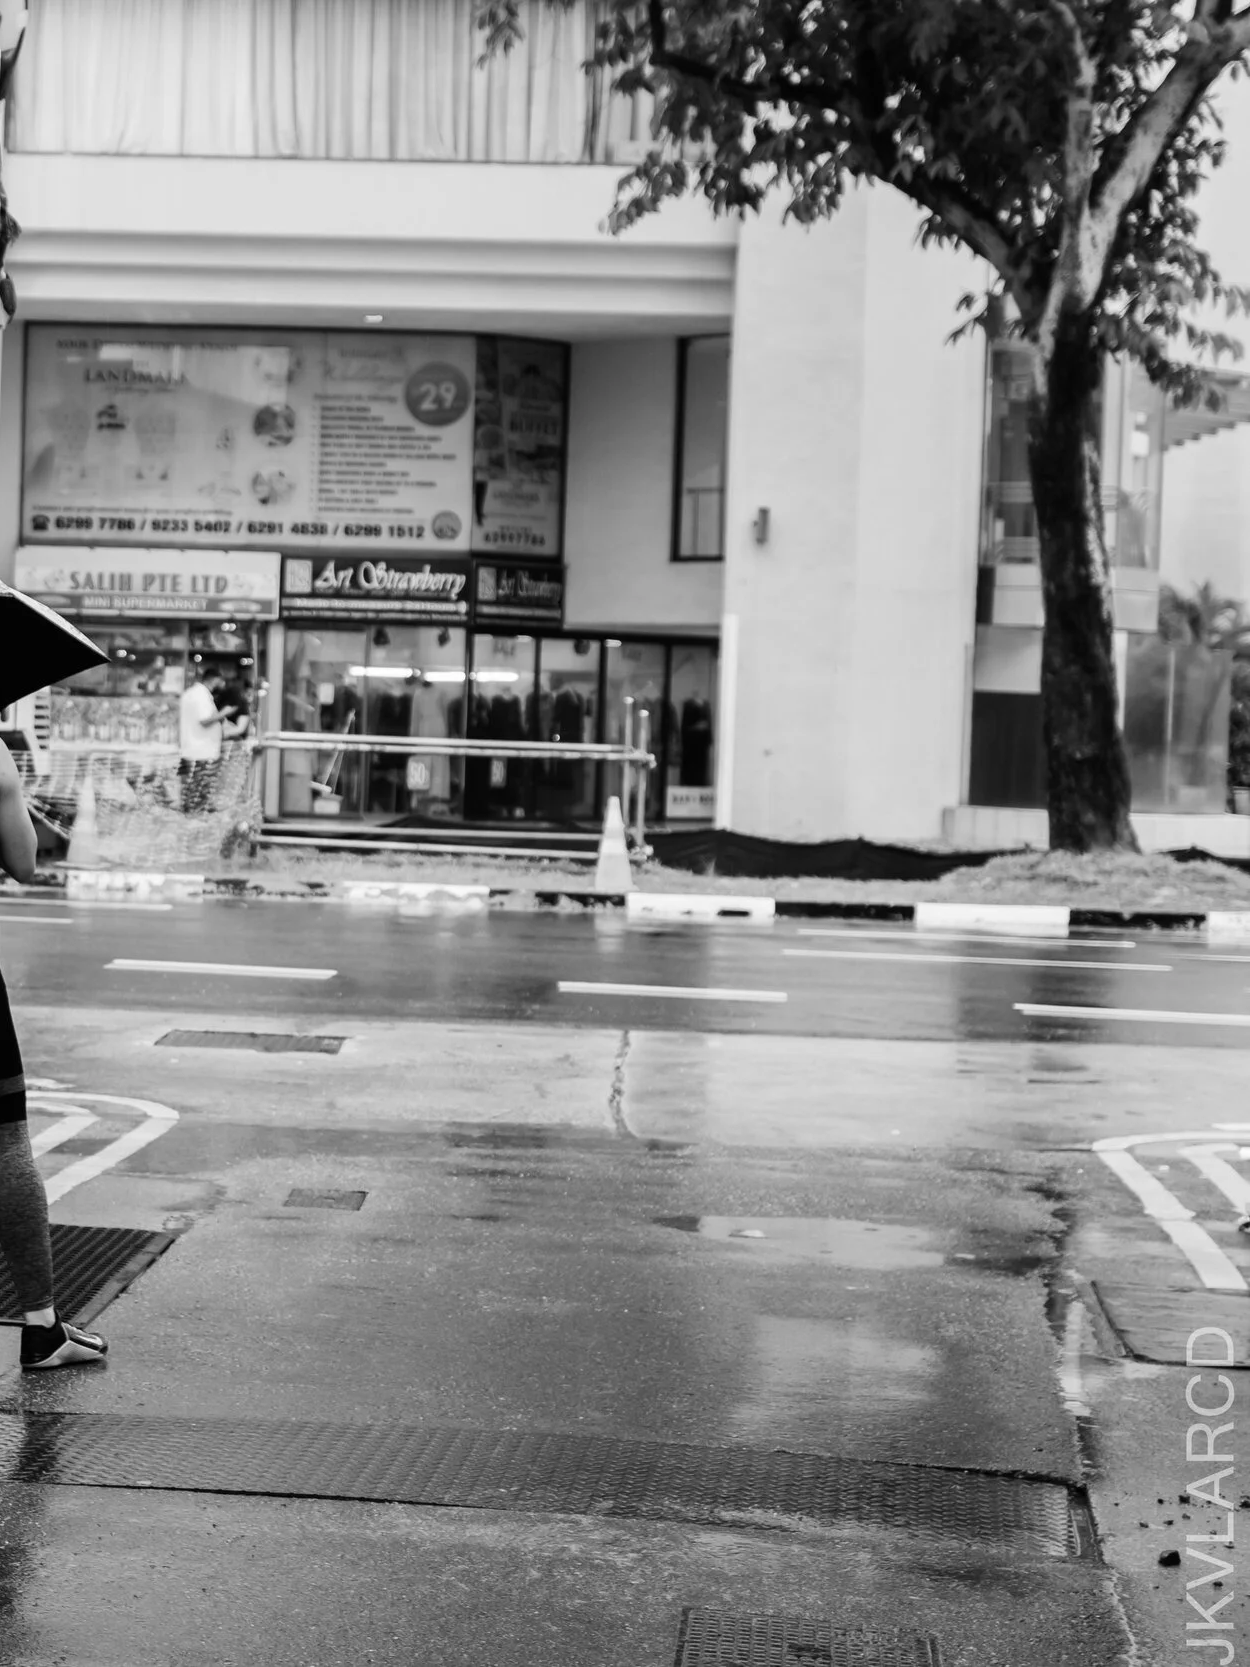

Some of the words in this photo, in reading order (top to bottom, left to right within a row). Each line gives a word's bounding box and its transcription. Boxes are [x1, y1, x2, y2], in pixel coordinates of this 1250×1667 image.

[419, 381, 457, 411] 29
[54, 515, 93, 530] 6299
[247, 521, 284, 534] 6291
[343, 523, 382, 537] 6299
[388, 525, 425, 539] 1512
[142, 572, 183, 593] PTE
[190, 574, 229, 594] LTD
[82, 595, 112, 608] MINI
[113, 597, 209, 611] SUPERMARKET
